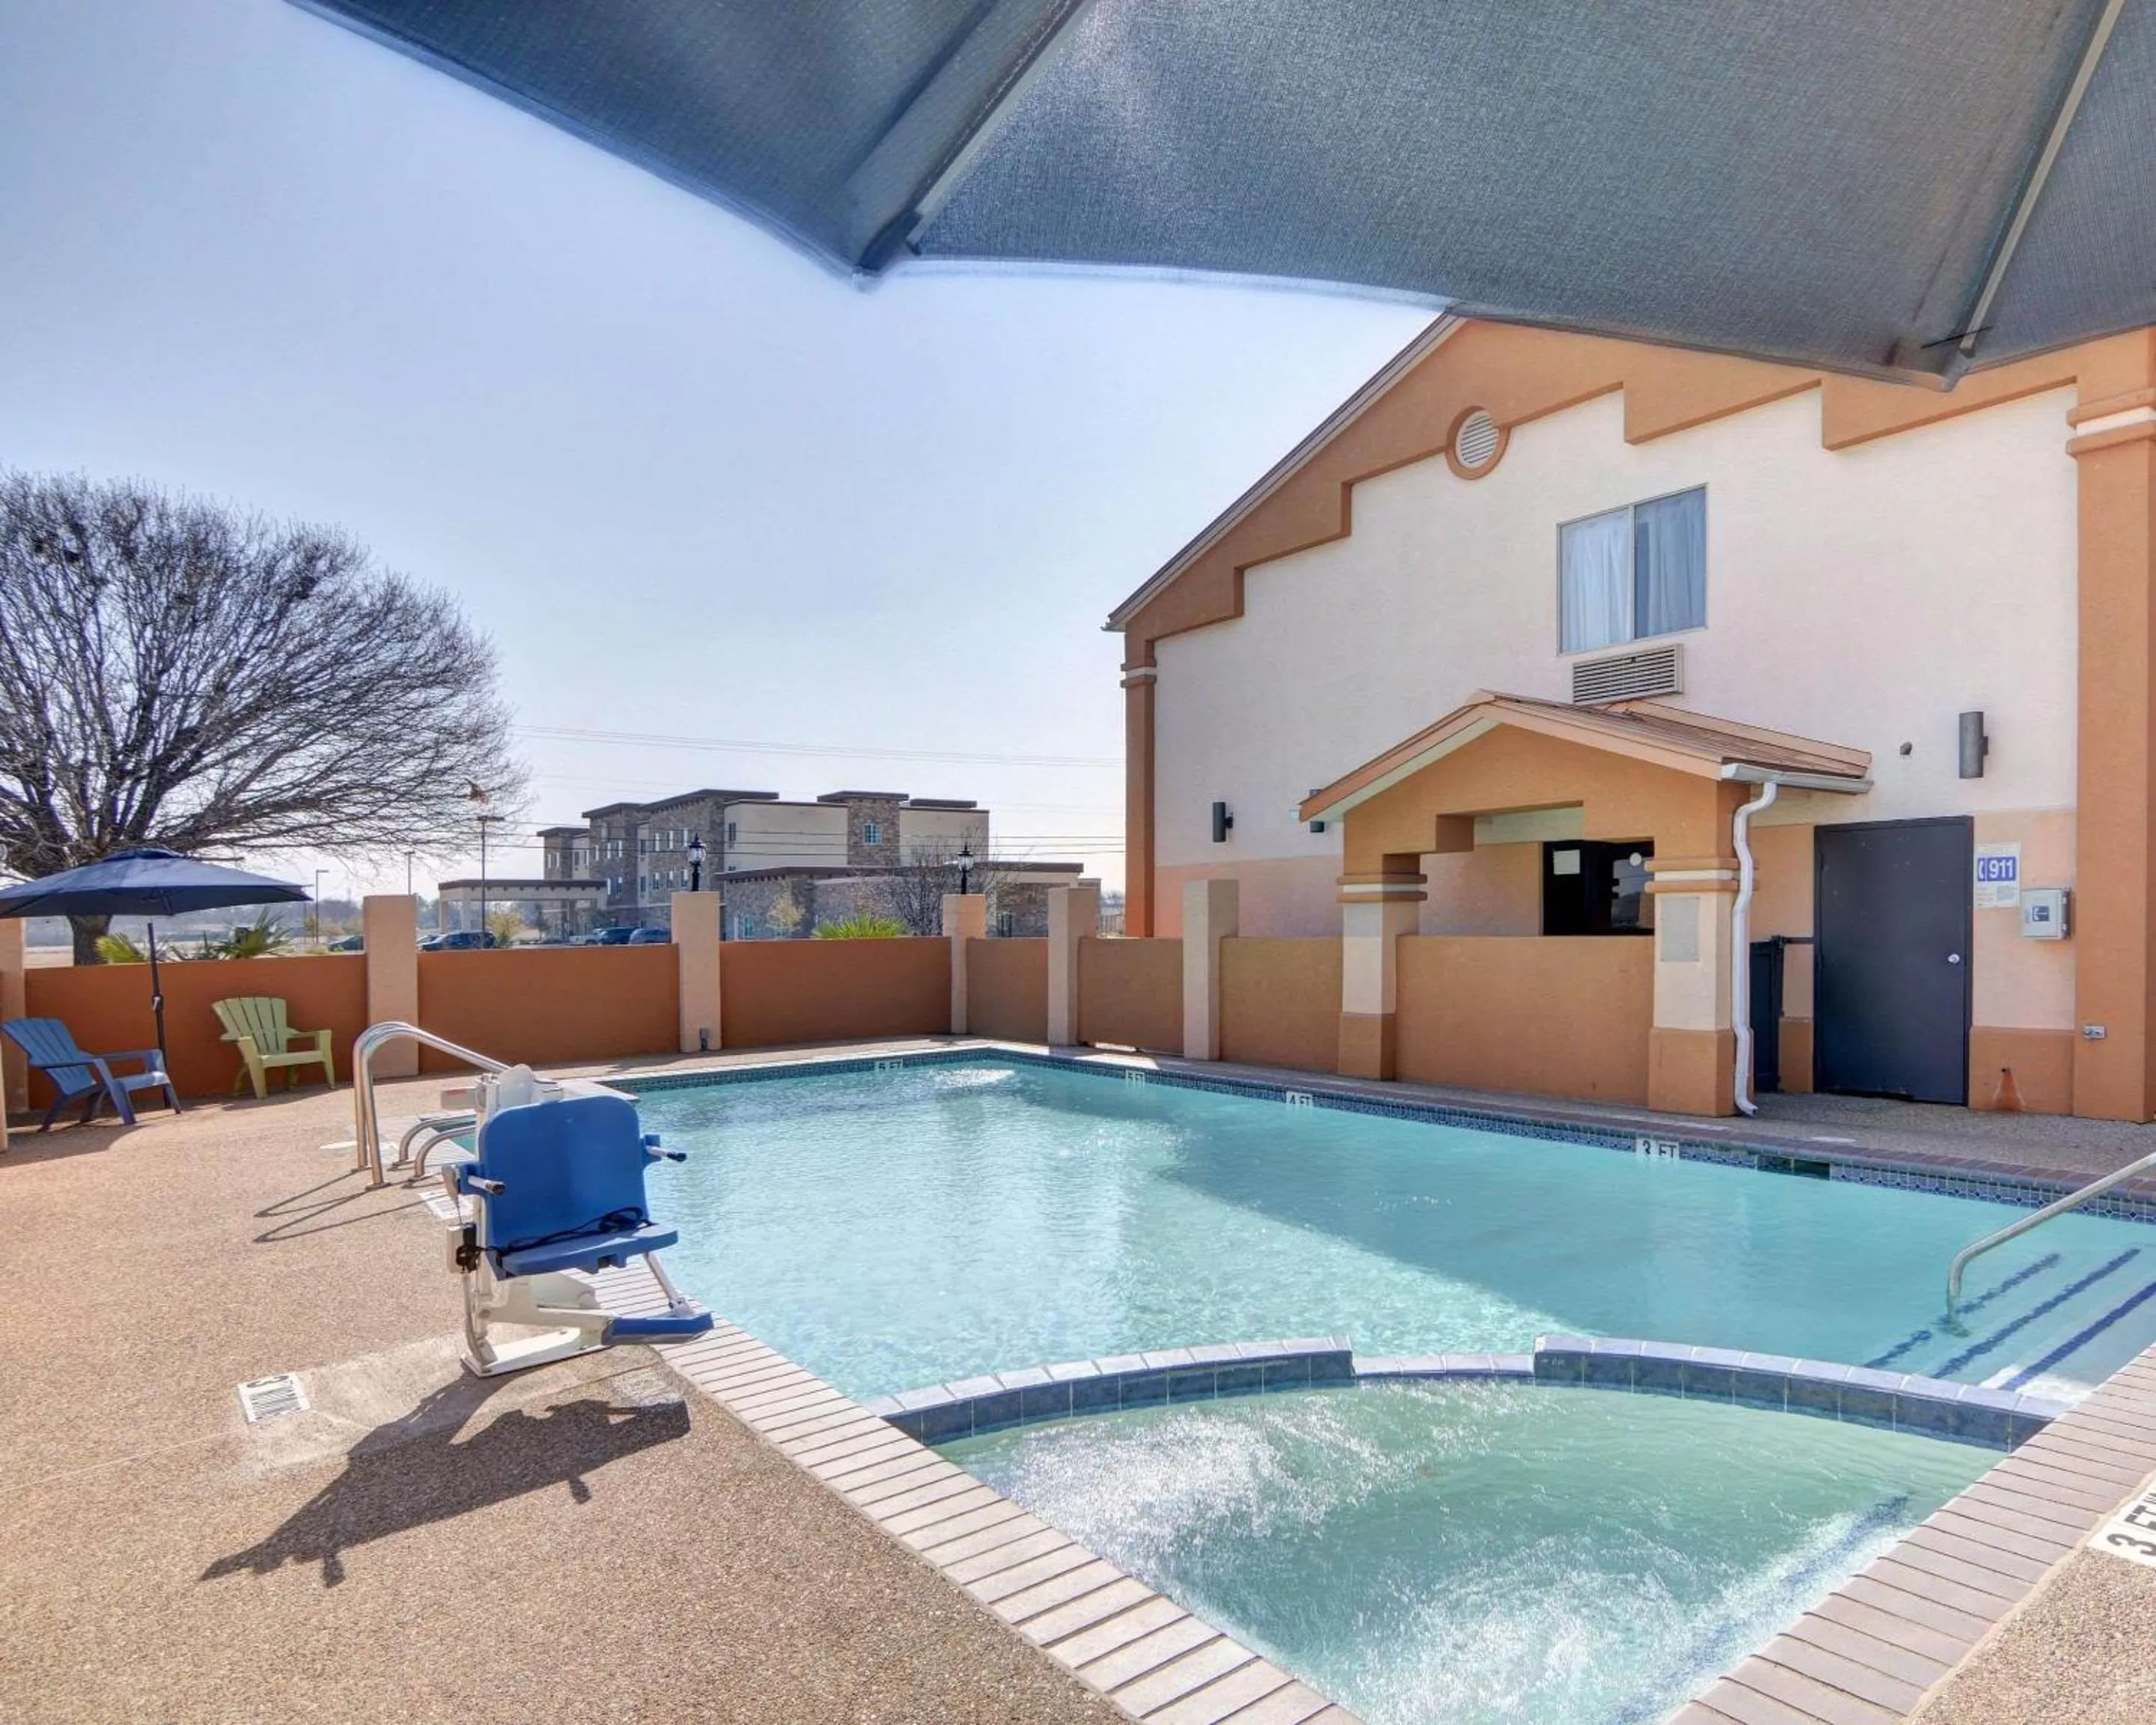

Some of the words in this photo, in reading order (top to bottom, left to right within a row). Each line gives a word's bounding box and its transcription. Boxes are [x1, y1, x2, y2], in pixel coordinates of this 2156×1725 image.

[1989, 859, 2014, 879] 911
[1658, 1143, 1677, 1158] FT
[2107, 1533, 2156, 1556] 3
